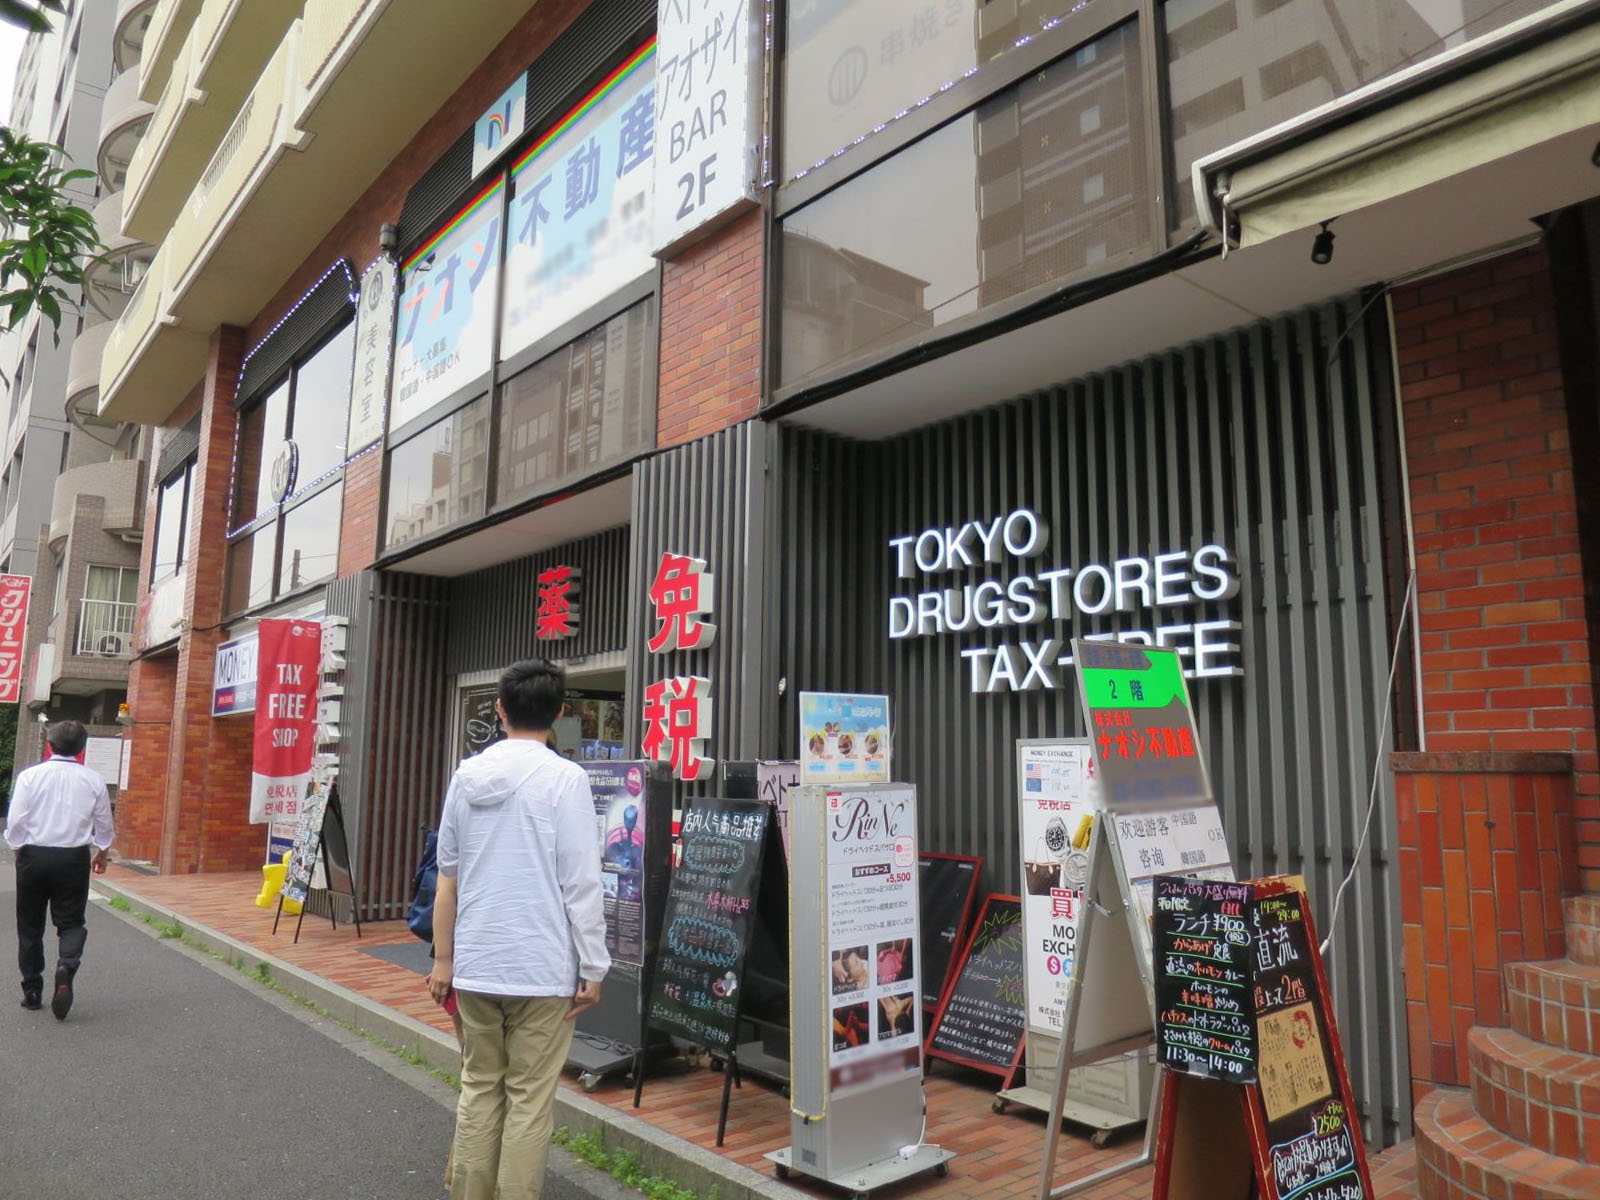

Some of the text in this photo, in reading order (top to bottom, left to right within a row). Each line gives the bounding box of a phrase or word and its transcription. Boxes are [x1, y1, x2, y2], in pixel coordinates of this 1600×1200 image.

[659, 0, 744, 120] アオザイ
[670, 89, 727, 164] BAR
[519, 88, 655, 247] 不動産
[676, 153, 717, 221] 2F
[889, 509, 1040, 578] TOKYO
[536, 565, 572, 639] 薬
[889, 545, 1230, 639] DRUGSTORES
[0, 590, 24, 698] クリーニング
[961, 620, 1242, 693] TAX-EE
[277, 664, 303, 685] TAX
[646, 552, 709, 782] 免税
[268, 694, 307, 719] FREE
[1094, 711, 1132, 727] 株式会社
[272, 728, 298, 747] SHOP
[1097, 726, 1197, 760] ナオシ不動産
[264, 801, 298, 816] 면세점
[1119, 816, 1169, 839] 欢迎游客
[1208, 828, 1224, 840] OK
[1139, 847, 1165, 868] 咨询
[1173, 913, 1245, 936] ランチ ¥900
[1253, 923, 1298, 972] 直流
[1048, 1017, 1062, 1027] TEL
